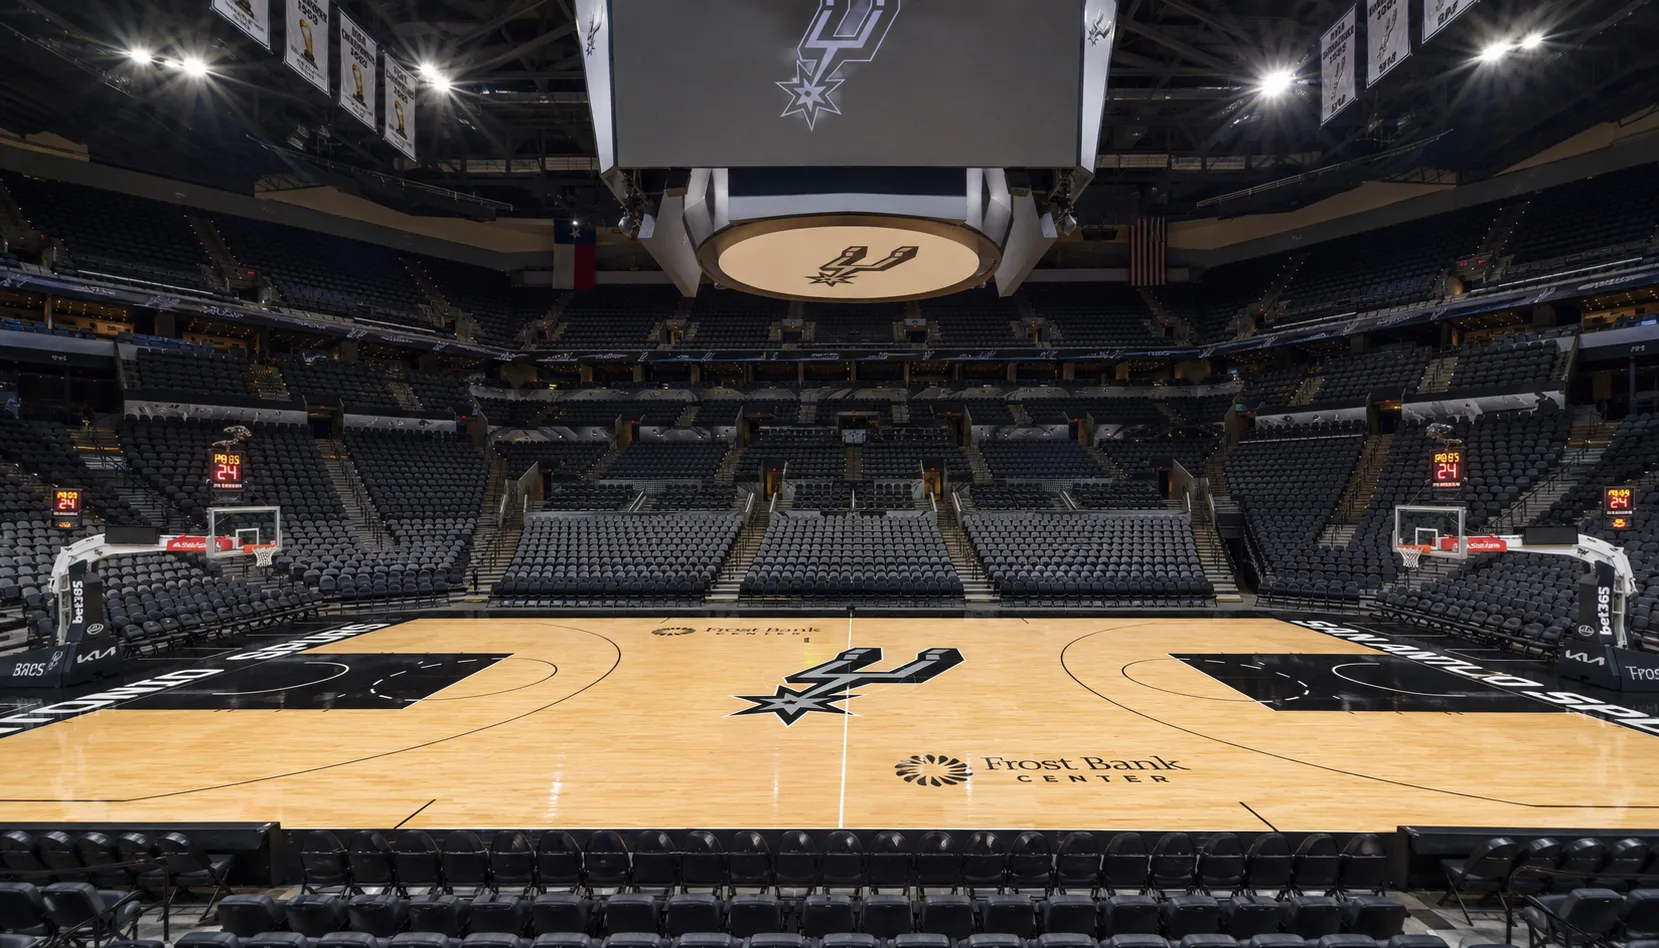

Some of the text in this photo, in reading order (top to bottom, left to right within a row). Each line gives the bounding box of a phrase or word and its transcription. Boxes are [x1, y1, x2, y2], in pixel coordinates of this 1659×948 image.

[217, 464, 237, 480] 24
[1437, 463, 1457, 479] 24
[59, 498, 75, 510] 24
[1610, 496, 1628, 509] 24
[1598, 586, 1612, 635] bet365
[981, 755, 1192, 771] Frost Bank
[1017, 774, 1171, 784] CENTER
